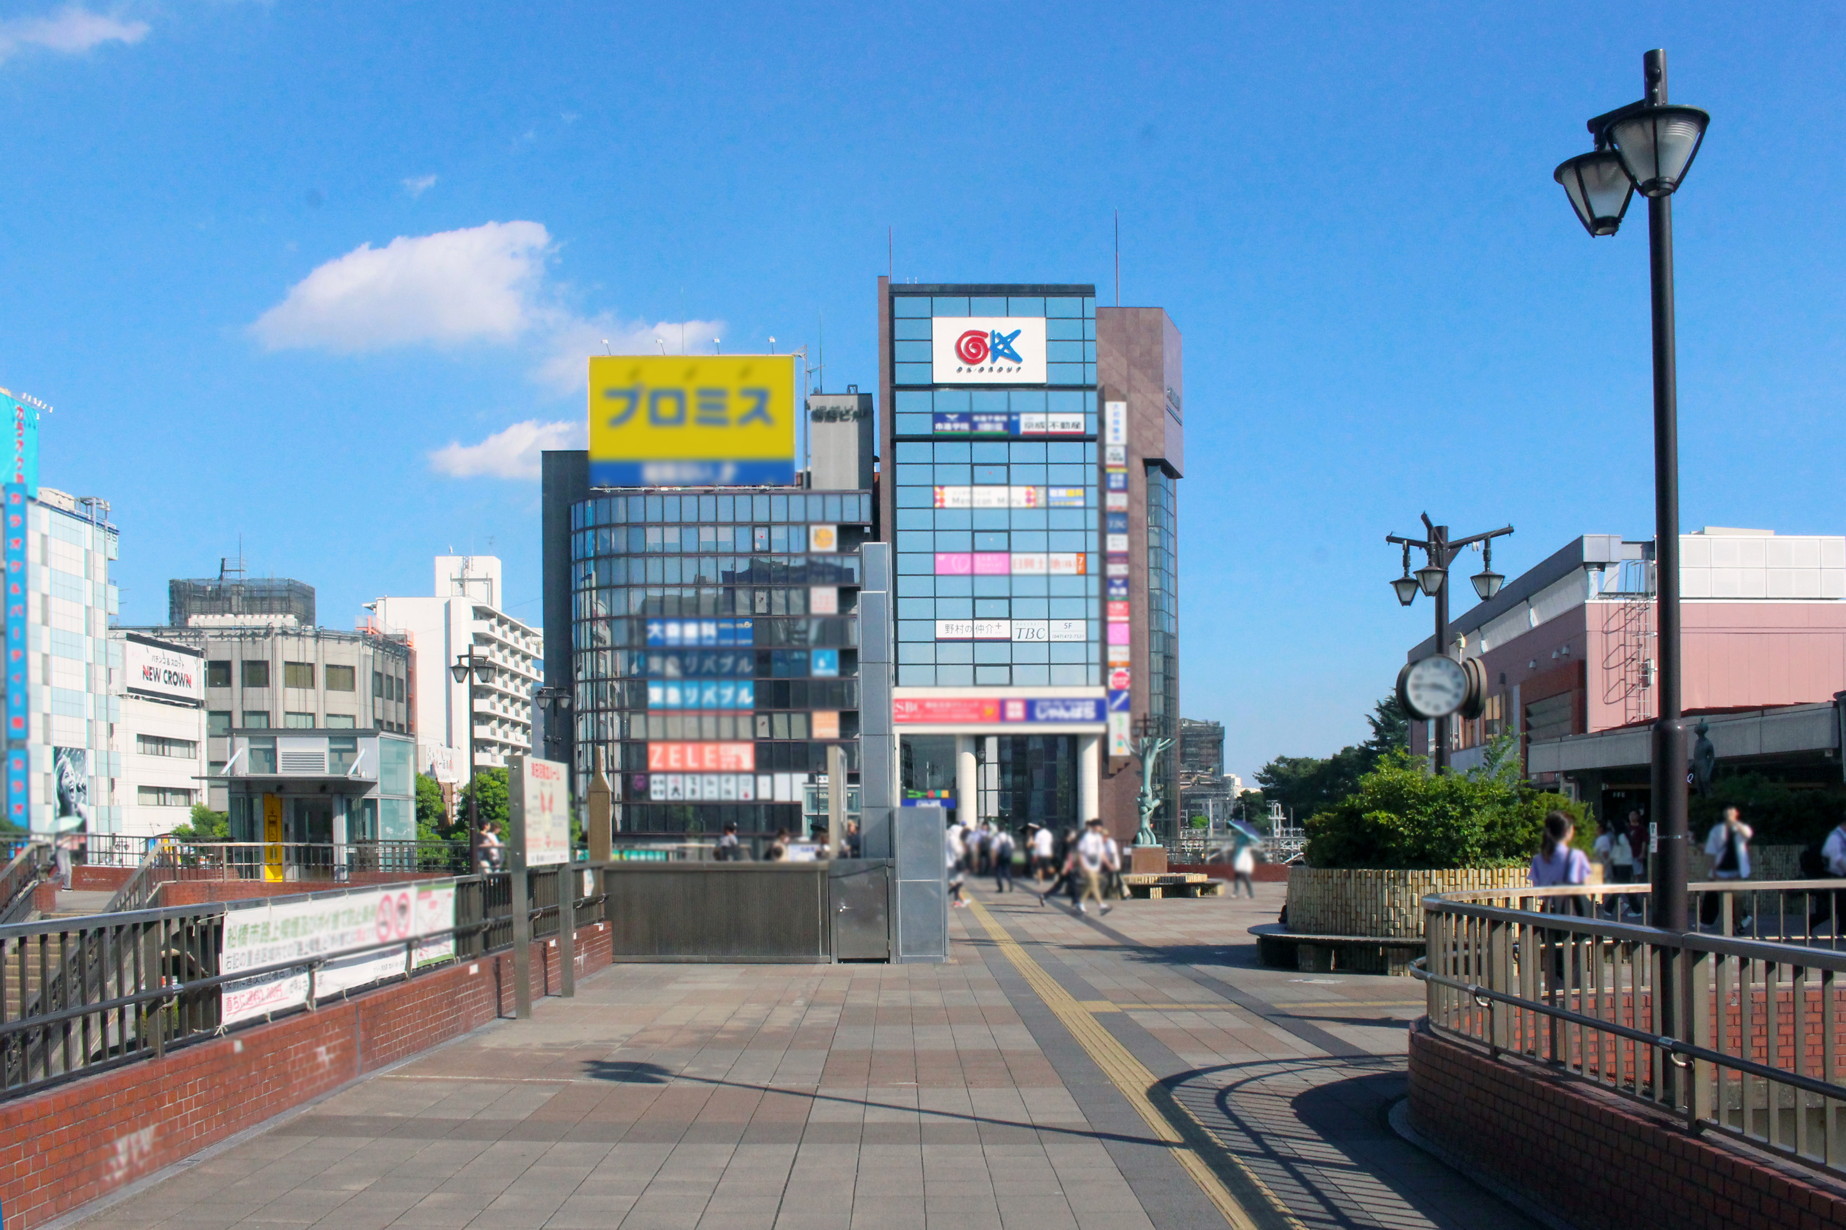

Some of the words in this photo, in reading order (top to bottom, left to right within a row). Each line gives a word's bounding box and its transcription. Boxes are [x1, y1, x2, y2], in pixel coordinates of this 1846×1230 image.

[604, 385, 775, 428] プロミス
[1015, 627, 1046, 640] TBC
[142, 664, 162, 683] NEW
[163, 668, 192, 689] CROWN
[649, 745, 717, 768] ZELE
